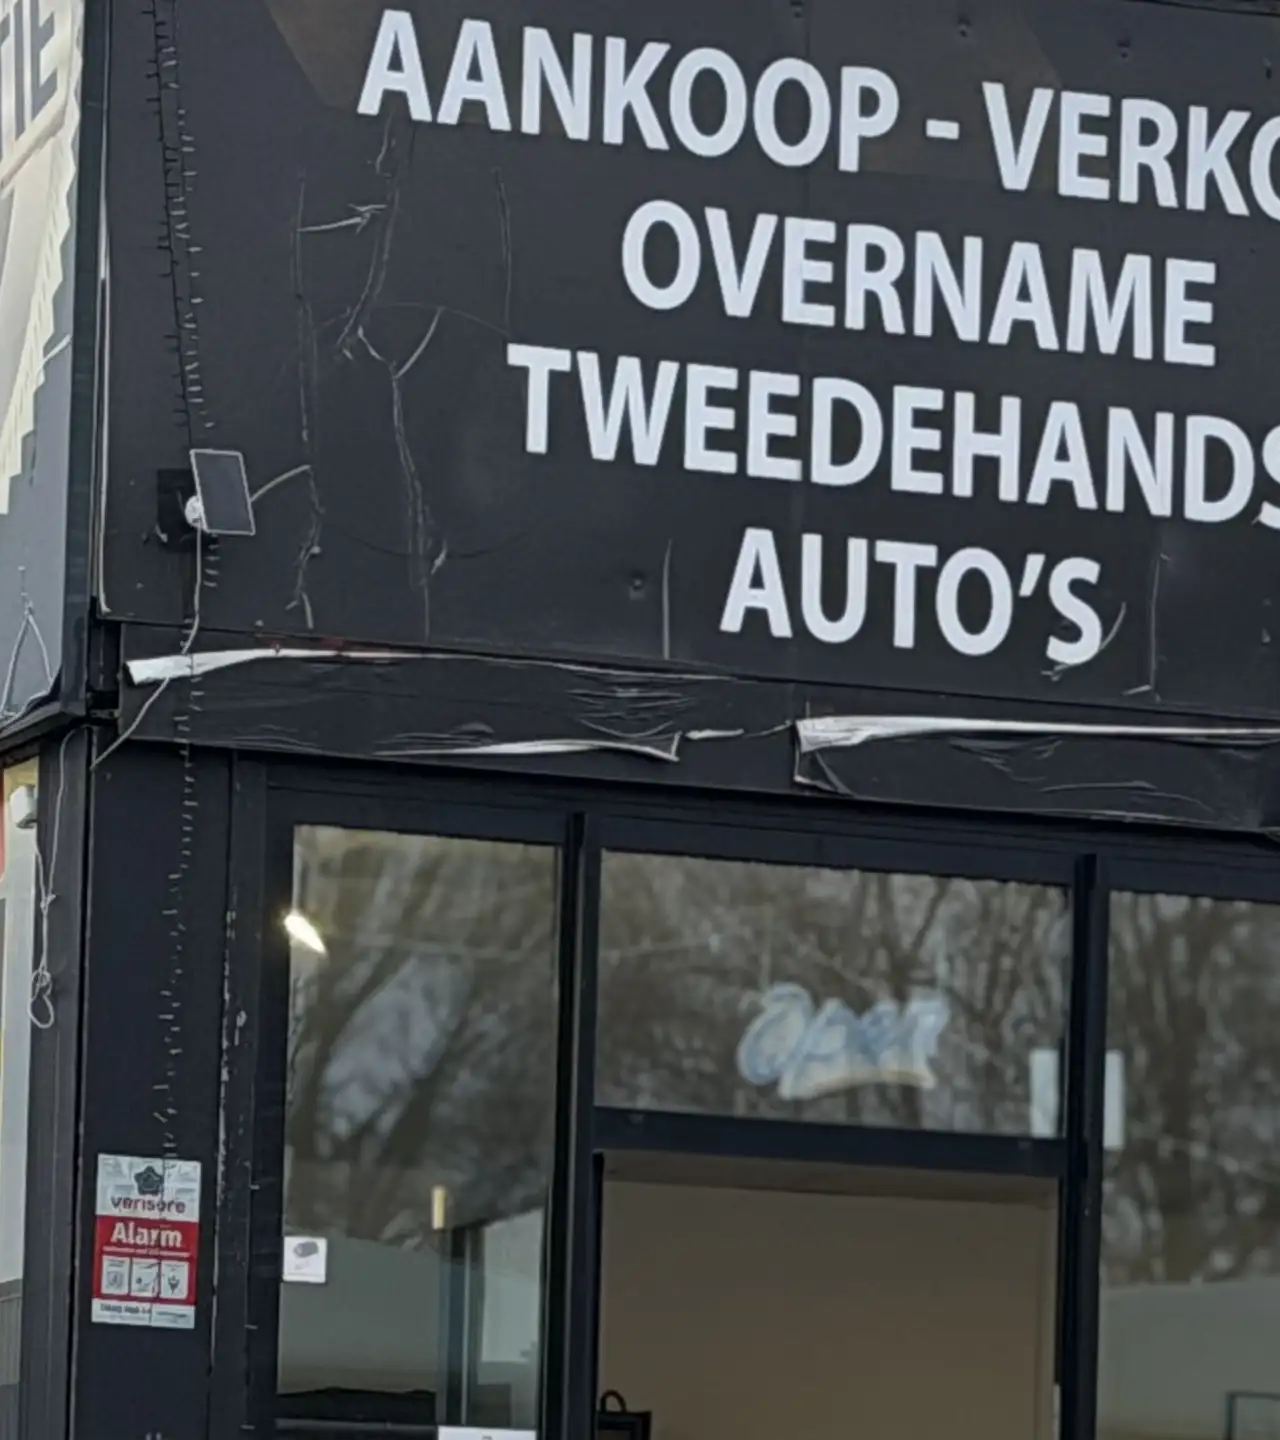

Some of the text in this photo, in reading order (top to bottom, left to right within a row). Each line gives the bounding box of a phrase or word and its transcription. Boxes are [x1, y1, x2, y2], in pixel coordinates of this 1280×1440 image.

[357, 9, 899, 174] AANKOOP
[925, 117, 961, 142] -
[622, 200, 1217, 367] OVERNAME
[720, 528, 1102, 667] AUTO'S
[110, 1221, 183, 1249] Alarm
